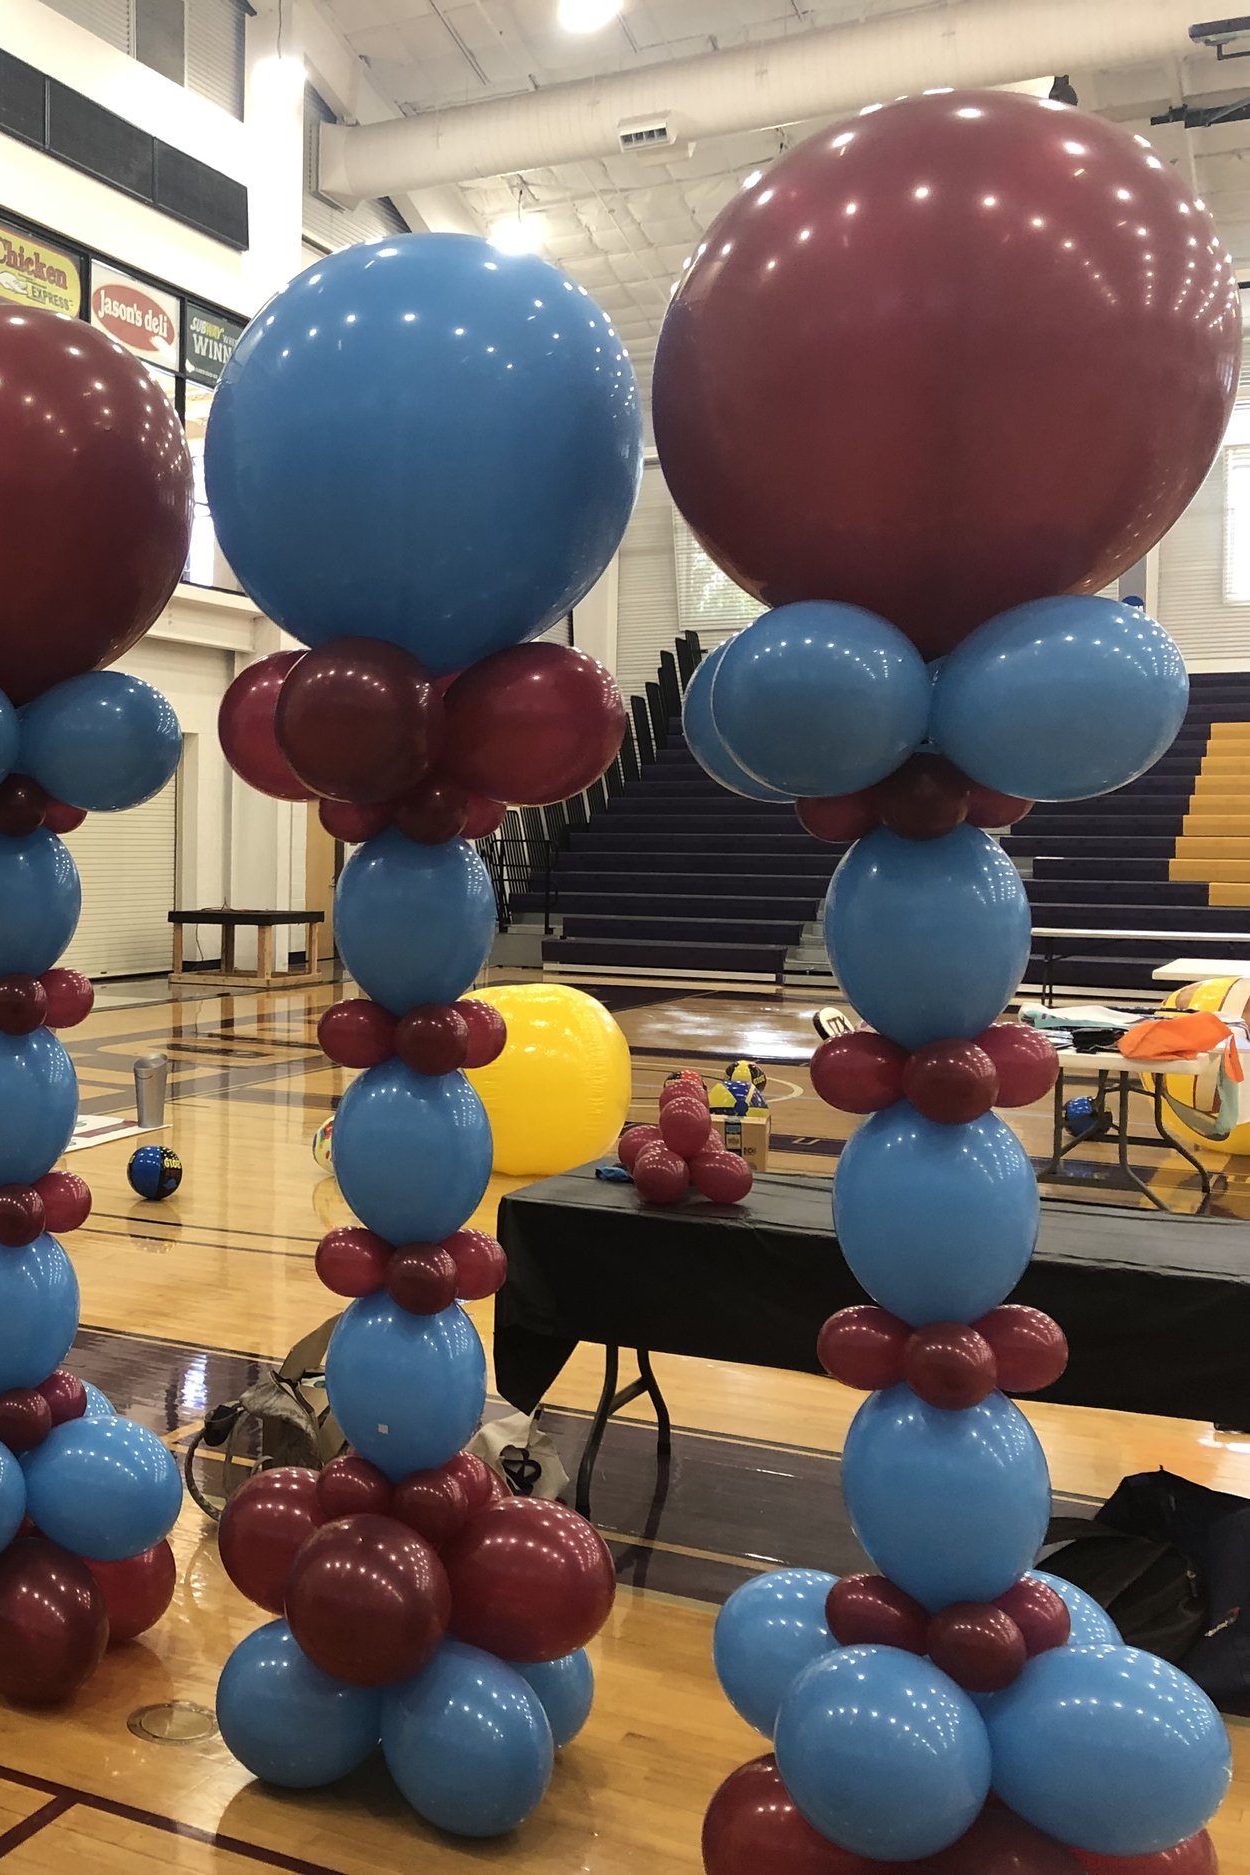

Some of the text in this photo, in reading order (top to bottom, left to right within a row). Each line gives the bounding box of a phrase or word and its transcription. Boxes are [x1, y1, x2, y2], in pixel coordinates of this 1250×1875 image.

[31, 285, 70, 311] EXPRESS
[98, 289, 168, 338] Jason's deli
[190, 316, 222, 340] SUBWAY
[192, 333, 233, 364] WINN
